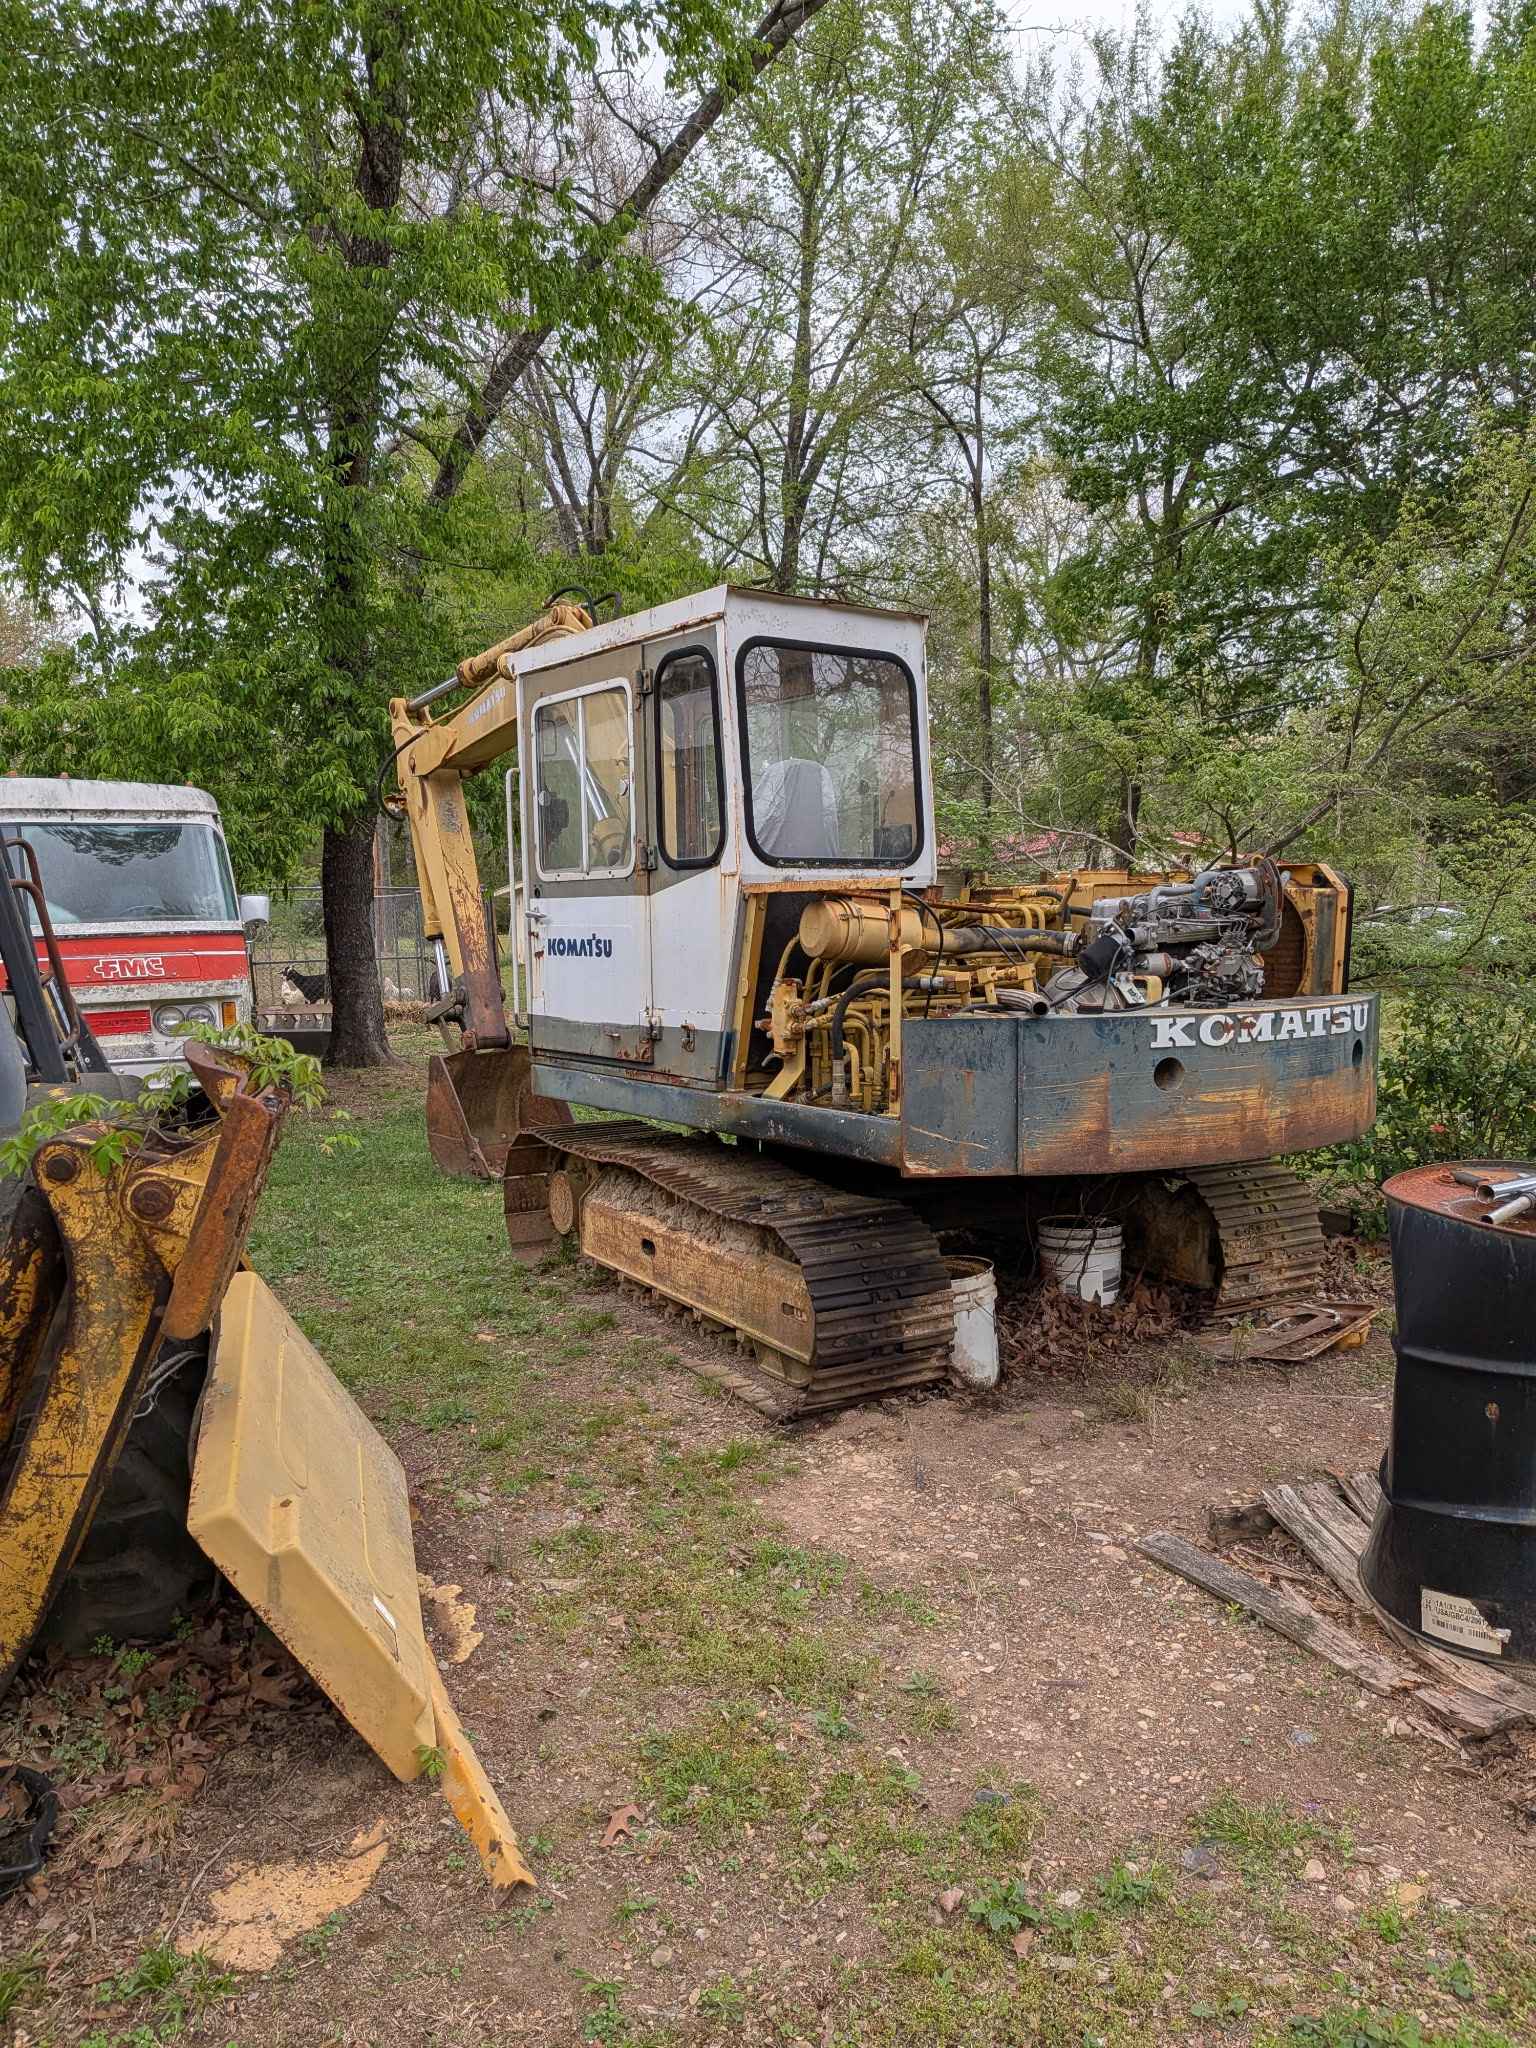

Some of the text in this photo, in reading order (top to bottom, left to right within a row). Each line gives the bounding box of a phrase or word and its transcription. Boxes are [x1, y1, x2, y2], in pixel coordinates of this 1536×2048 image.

[548, 934, 612, 958] KOMATSU
[94, 957, 165, 979] FMC
[1150, 1002, 1369, 1049] KOMATSU
